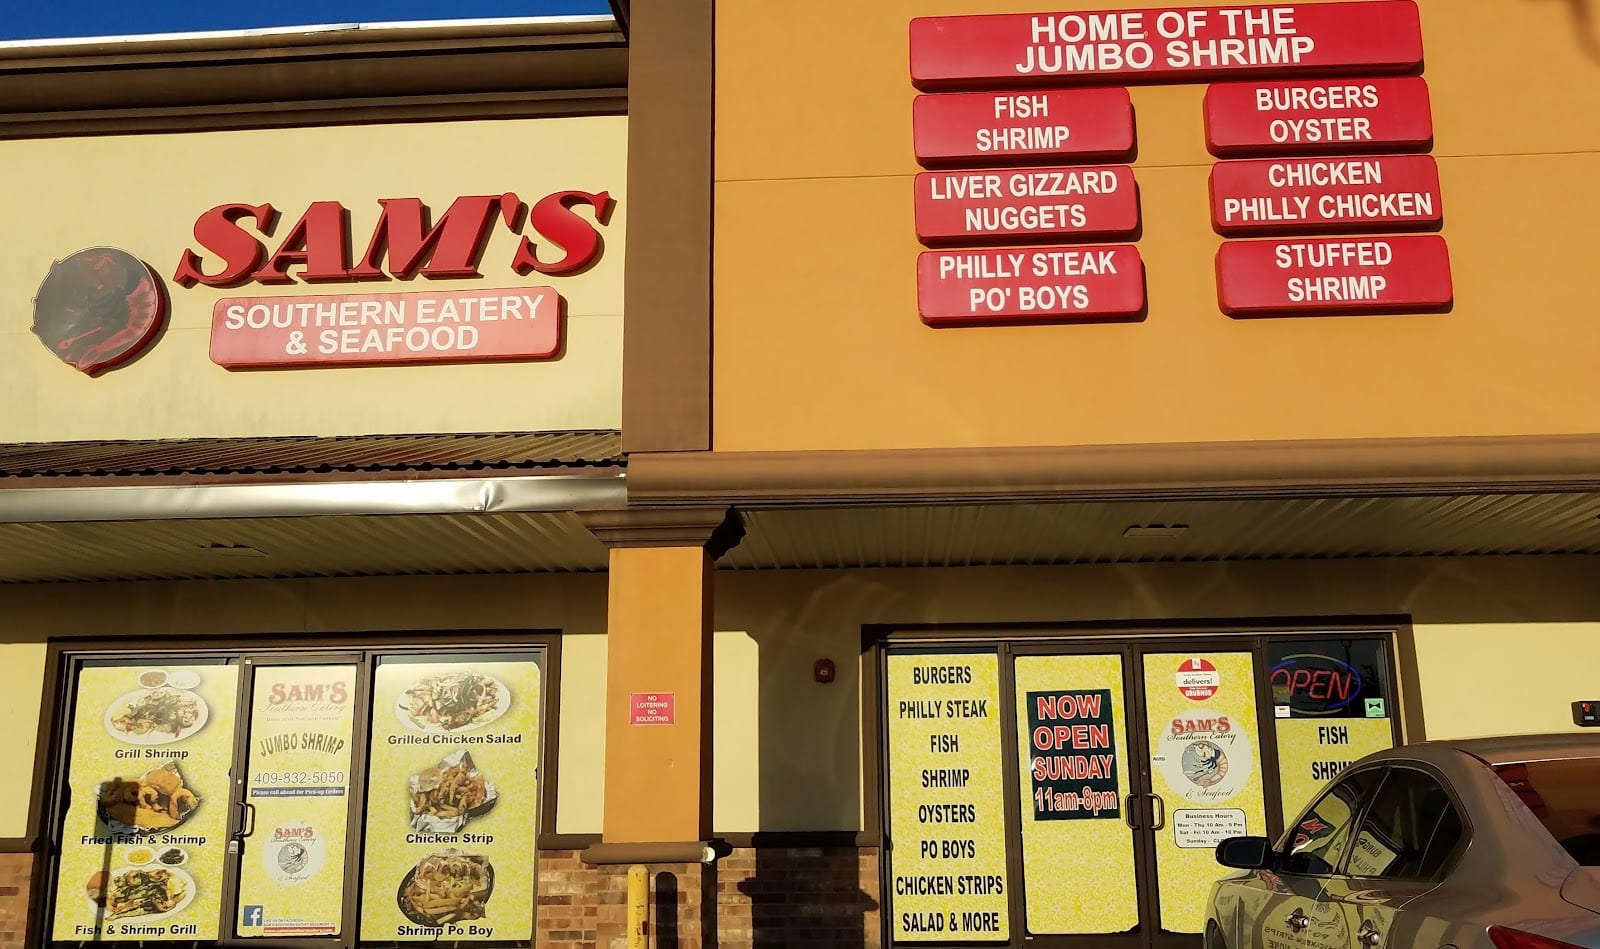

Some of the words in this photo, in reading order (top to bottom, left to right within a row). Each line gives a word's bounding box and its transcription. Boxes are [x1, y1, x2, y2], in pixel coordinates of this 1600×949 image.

[1031, 13, 1144, 43] HOME
[1156, 11, 1207, 39] OF
[1218, 8, 1297, 36] THE
[1015, 42, 1153, 74] JUMBO
[1166, 36, 1315, 68] SHRIMP
[994, 95, 1049, 120] FISH
[1256, 84, 1379, 111] BURGERS
[976, 126, 1070, 152] SHRIMP
[1269, 118, 1372, 143] OYSTER
[931, 175, 1002, 200] LIVER
[1009, 171, 1117, 197] GIZZARD
[1267, 161, 1382, 188] CHICKEN
[965, 204, 1087, 231] NUGGETS
[1224, 195, 1313, 222] PHILLY
[1318, 192, 1433, 219] CHICKEN
[172, 190, 616, 288] SAM'S
[939, 253, 1024, 279] PHILLY
[1032, 250, 1117, 276] STEAK
[1275, 242, 1393, 269] STUFFED
[969, 287, 1011, 312] PO'
[1021, 285, 1089, 311] BOYS
[1287, 275, 1388, 302] SHRIMP
[225, 301, 405, 330] SOUTHERN
[416, 294, 544, 325] EATERY
[285, 331, 307, 355] &
[319, 325, 479, 354] SEAFOOD
[913, 666, 972, 685] BURGERS
[1269, 668, 1353, 700] OPEN
[268, 681, 348, 705] SAM'S
[900, 701, 941, 719] PHILLY
[946, 700, 988, 718] STEAK
[1036, 695, 1102, 720] NOW
[1033, 725, 1110, 750] OPEN
[1167, 733, 1207, 742] Southern
[1210, 730, 1237, 745] Eatery
[1171, 716, 1231, 735] SAM'S
[1318, 726, 1349, 745] FISH
[260, 733, 298, 757] JUMBO
[301, 732, 345, 755] SHRIMP
[388, 735, 430, 745] Grilled
[432, 734, 484, 745] Chicken
[485, 733, 522, 744] Salad
[930, 735, 959, 753] FISH
[115, 749, 142, 759] Grill
[145, 748, 189, 760] Shrimp
[254, 771, 344, 784] 409-832-5050
[922, 769, 970, 788] SHRIMP
[1034, 755, 1113, 781] SUNDAY
[1312, 761, 1355, 780] SHRI
[252, 788, 270, 796] Please
[1034, 786, 1118, 816] 11am-8pm
[1197, 787, 1234, 800] Seafood
[918, 804, 976, 823] OYSTERS
[81, 835, 114, 845] Fried
[116, 834, 143, 845] Fish
[148, 835, 157, 845] &
[161, 834, 206, 847] Shrimp
[274, 826, 314, 840] SAM'S
[406, 833, 458, 844] Chicken
[462, 833, 494, 845] Strip
[921, 840, 938, 859] PO
[942, 839, 975, 859] BOYS
[896, 876, 953, 895] CHICKEN
[957, 875, 1003, 894] STRIPS
[75, 925, 101, 935] Fish
[106, 925, 115, 935] &
[120, 924, 166, 937] Shrimp
[170, 924, 197, 935] Grill
[397, 925, 444, 938] Shrimp
[448, 925, 464, 936] Po
[469, 925, 493, 938] Boy
[902, 912, 944, 932] SALAD
[949, 912, 958, 931] &
[962, 912, 1000, 931] MORE
